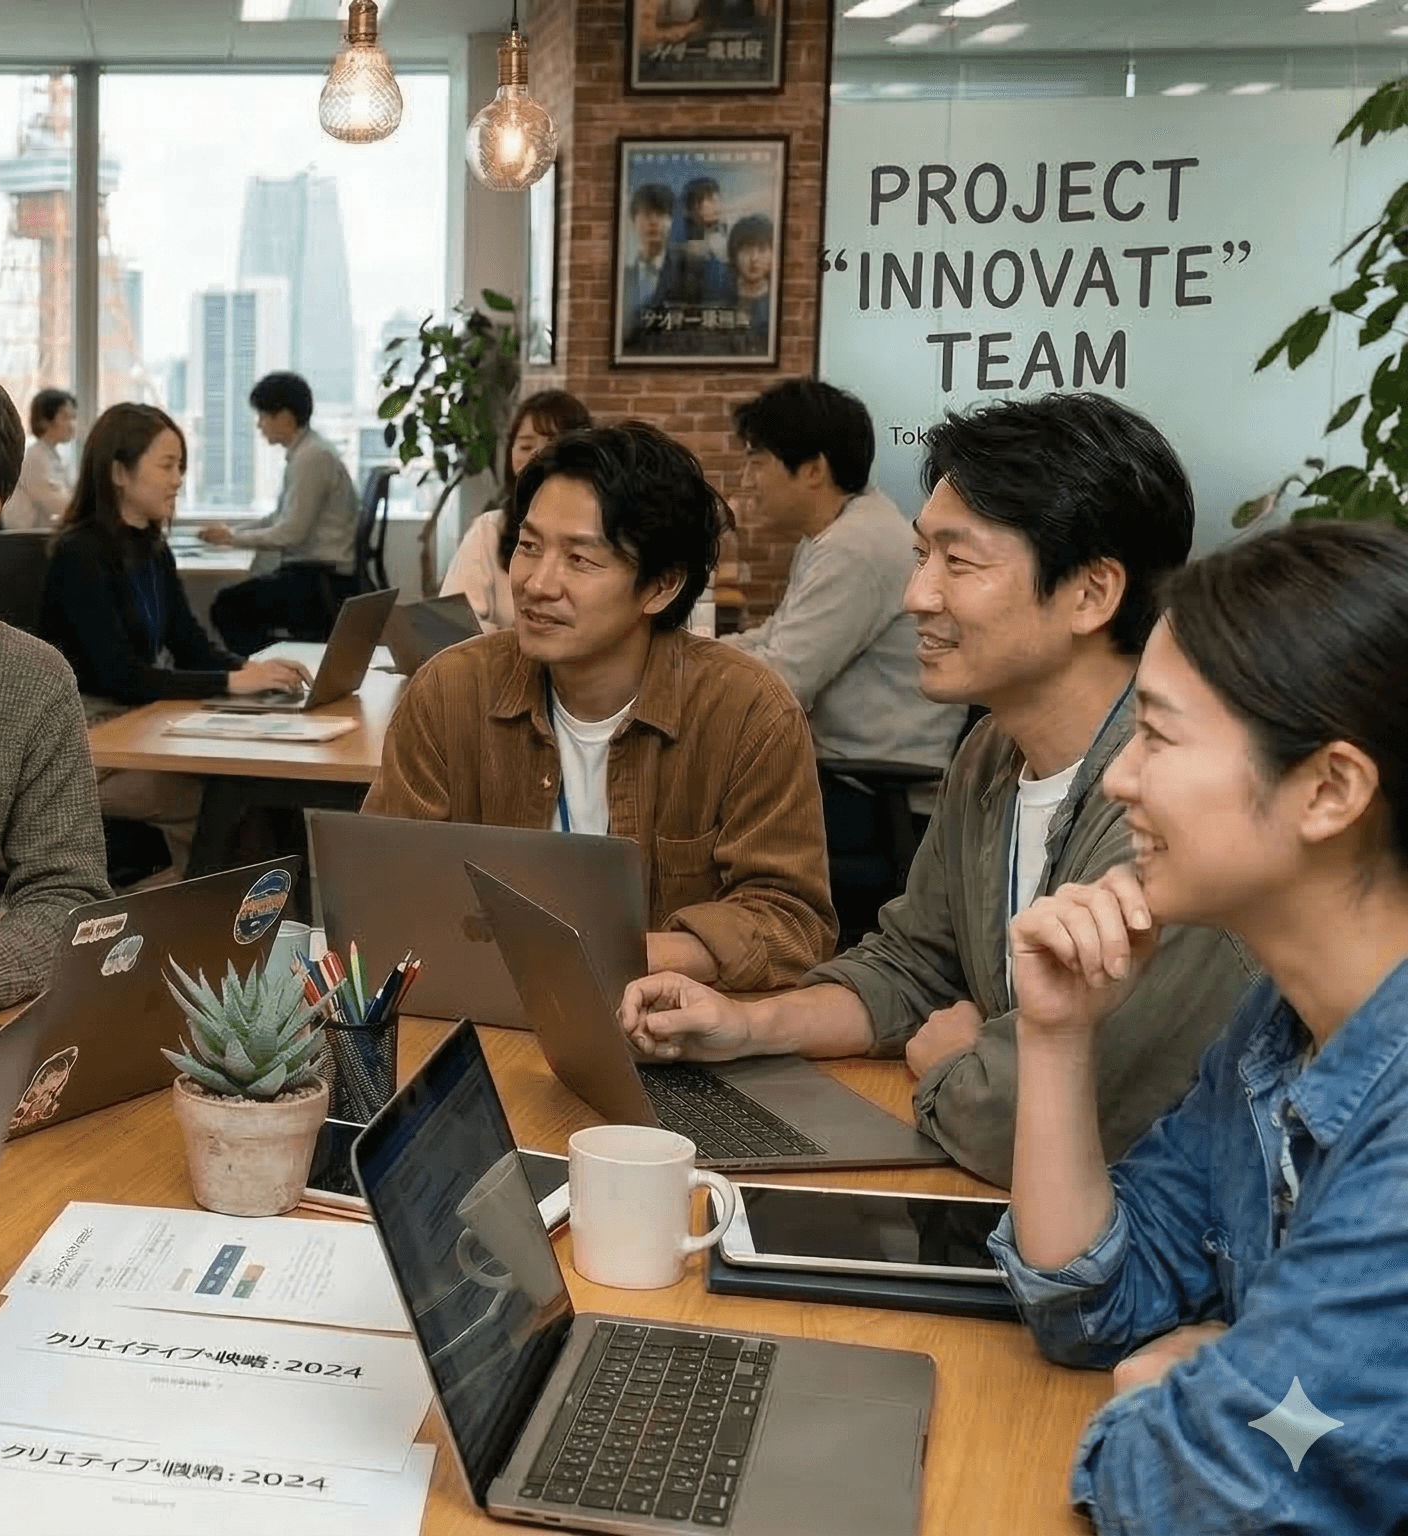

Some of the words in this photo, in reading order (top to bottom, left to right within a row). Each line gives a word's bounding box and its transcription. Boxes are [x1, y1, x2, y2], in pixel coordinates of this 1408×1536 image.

[870, 157, 1199, 226] PROJECT
[818, 239, 1252, 311] “INNOVATE”
[926, 329, 1127, 393] TEAM
[888, 425, 930, 448] Tok
